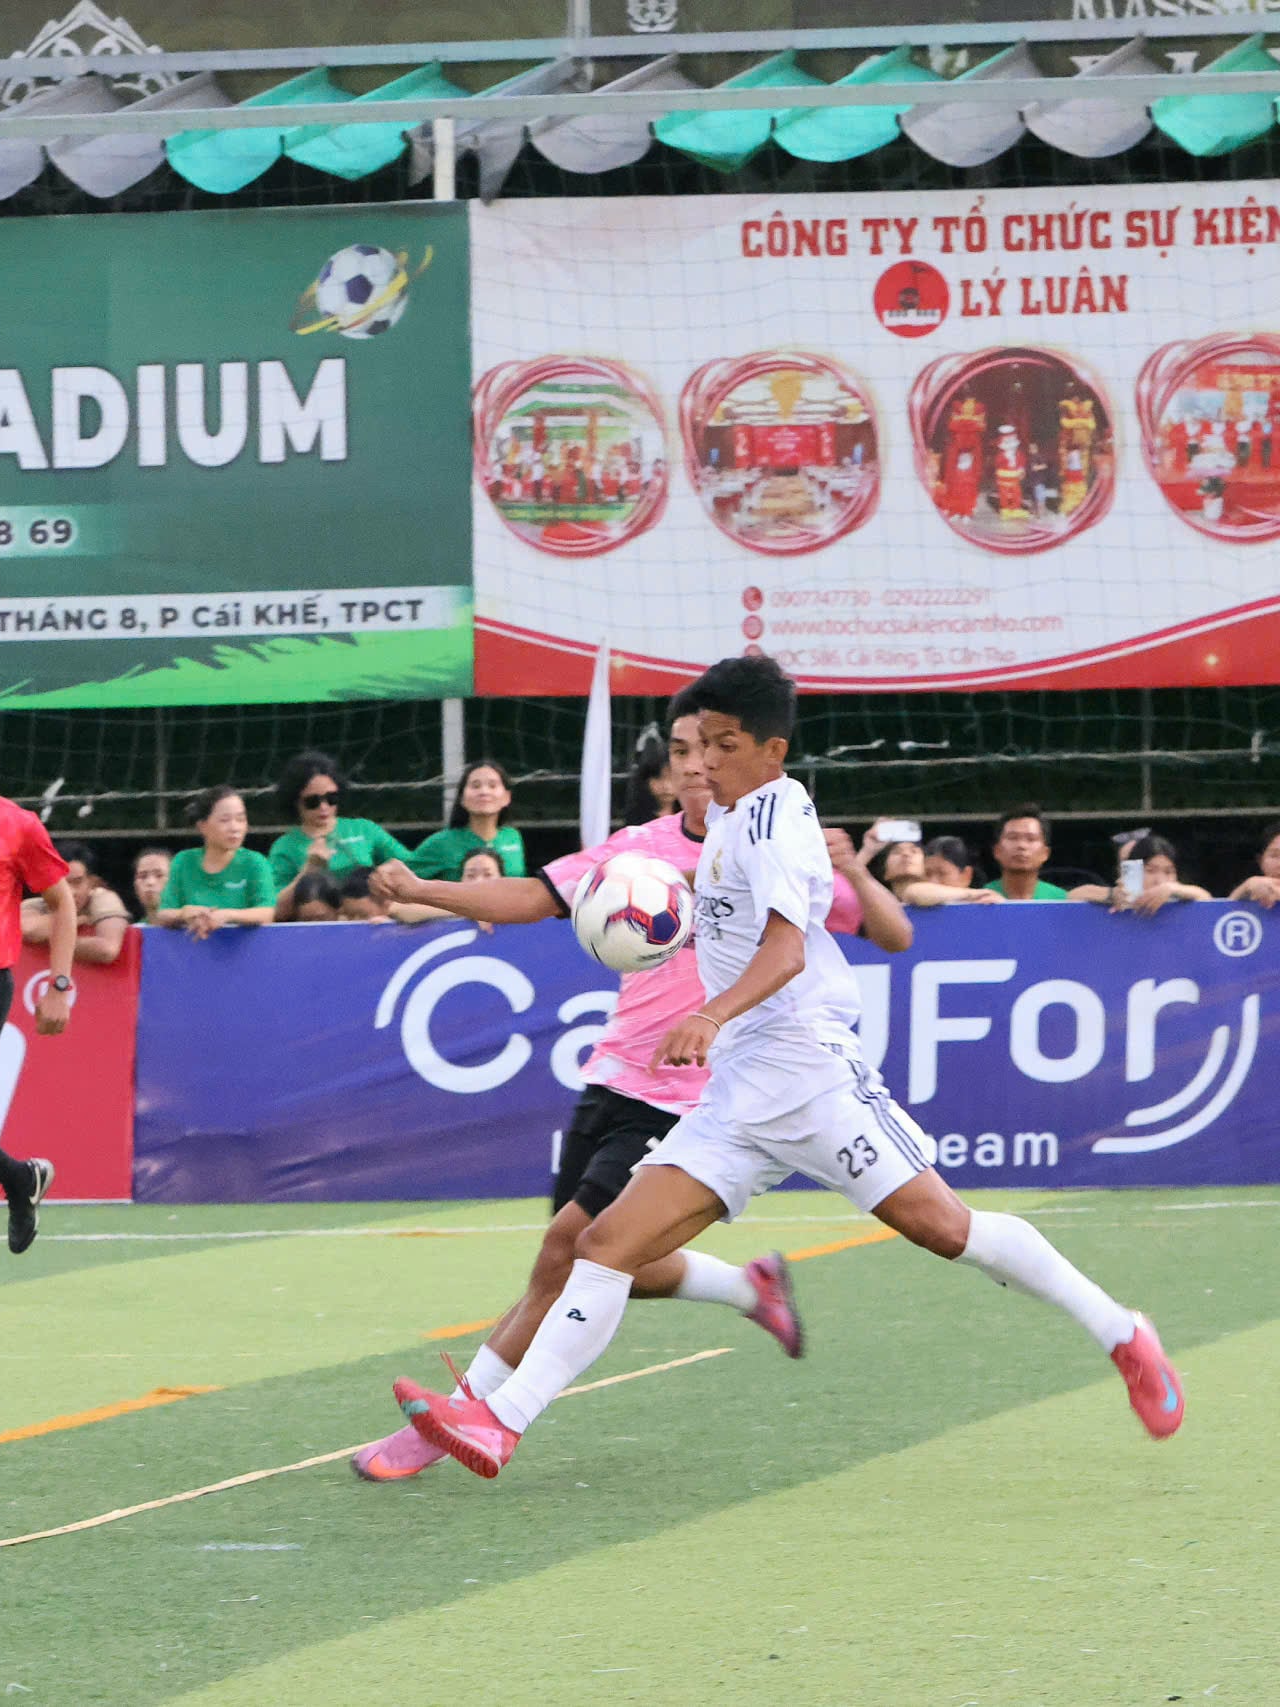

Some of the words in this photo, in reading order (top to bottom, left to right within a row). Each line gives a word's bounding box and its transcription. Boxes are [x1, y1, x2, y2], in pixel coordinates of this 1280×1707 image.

[742, 210, 848, 258] CÔNG
[862, 217, 919, 256] TY
[933, 195, 987, 254] TỔ
[1003, 202, 1112, 252] CHỨC
[1126, 205, 1182, 258] SỰ
[960, 268, 1007, 317] LÝ
[1020, 267, 1129, 315] LUÂN
[29, 518, 74, 545] 69
[120, 608, 149, 634] 8,
[160, 607, 180, 629] P
[192, 601, 243, 628] Cái
[255, 594, 330, 628] KHẾ,
[340, 599, 425, 624] TPCT
[836, 1134, 879, 1180] 23
